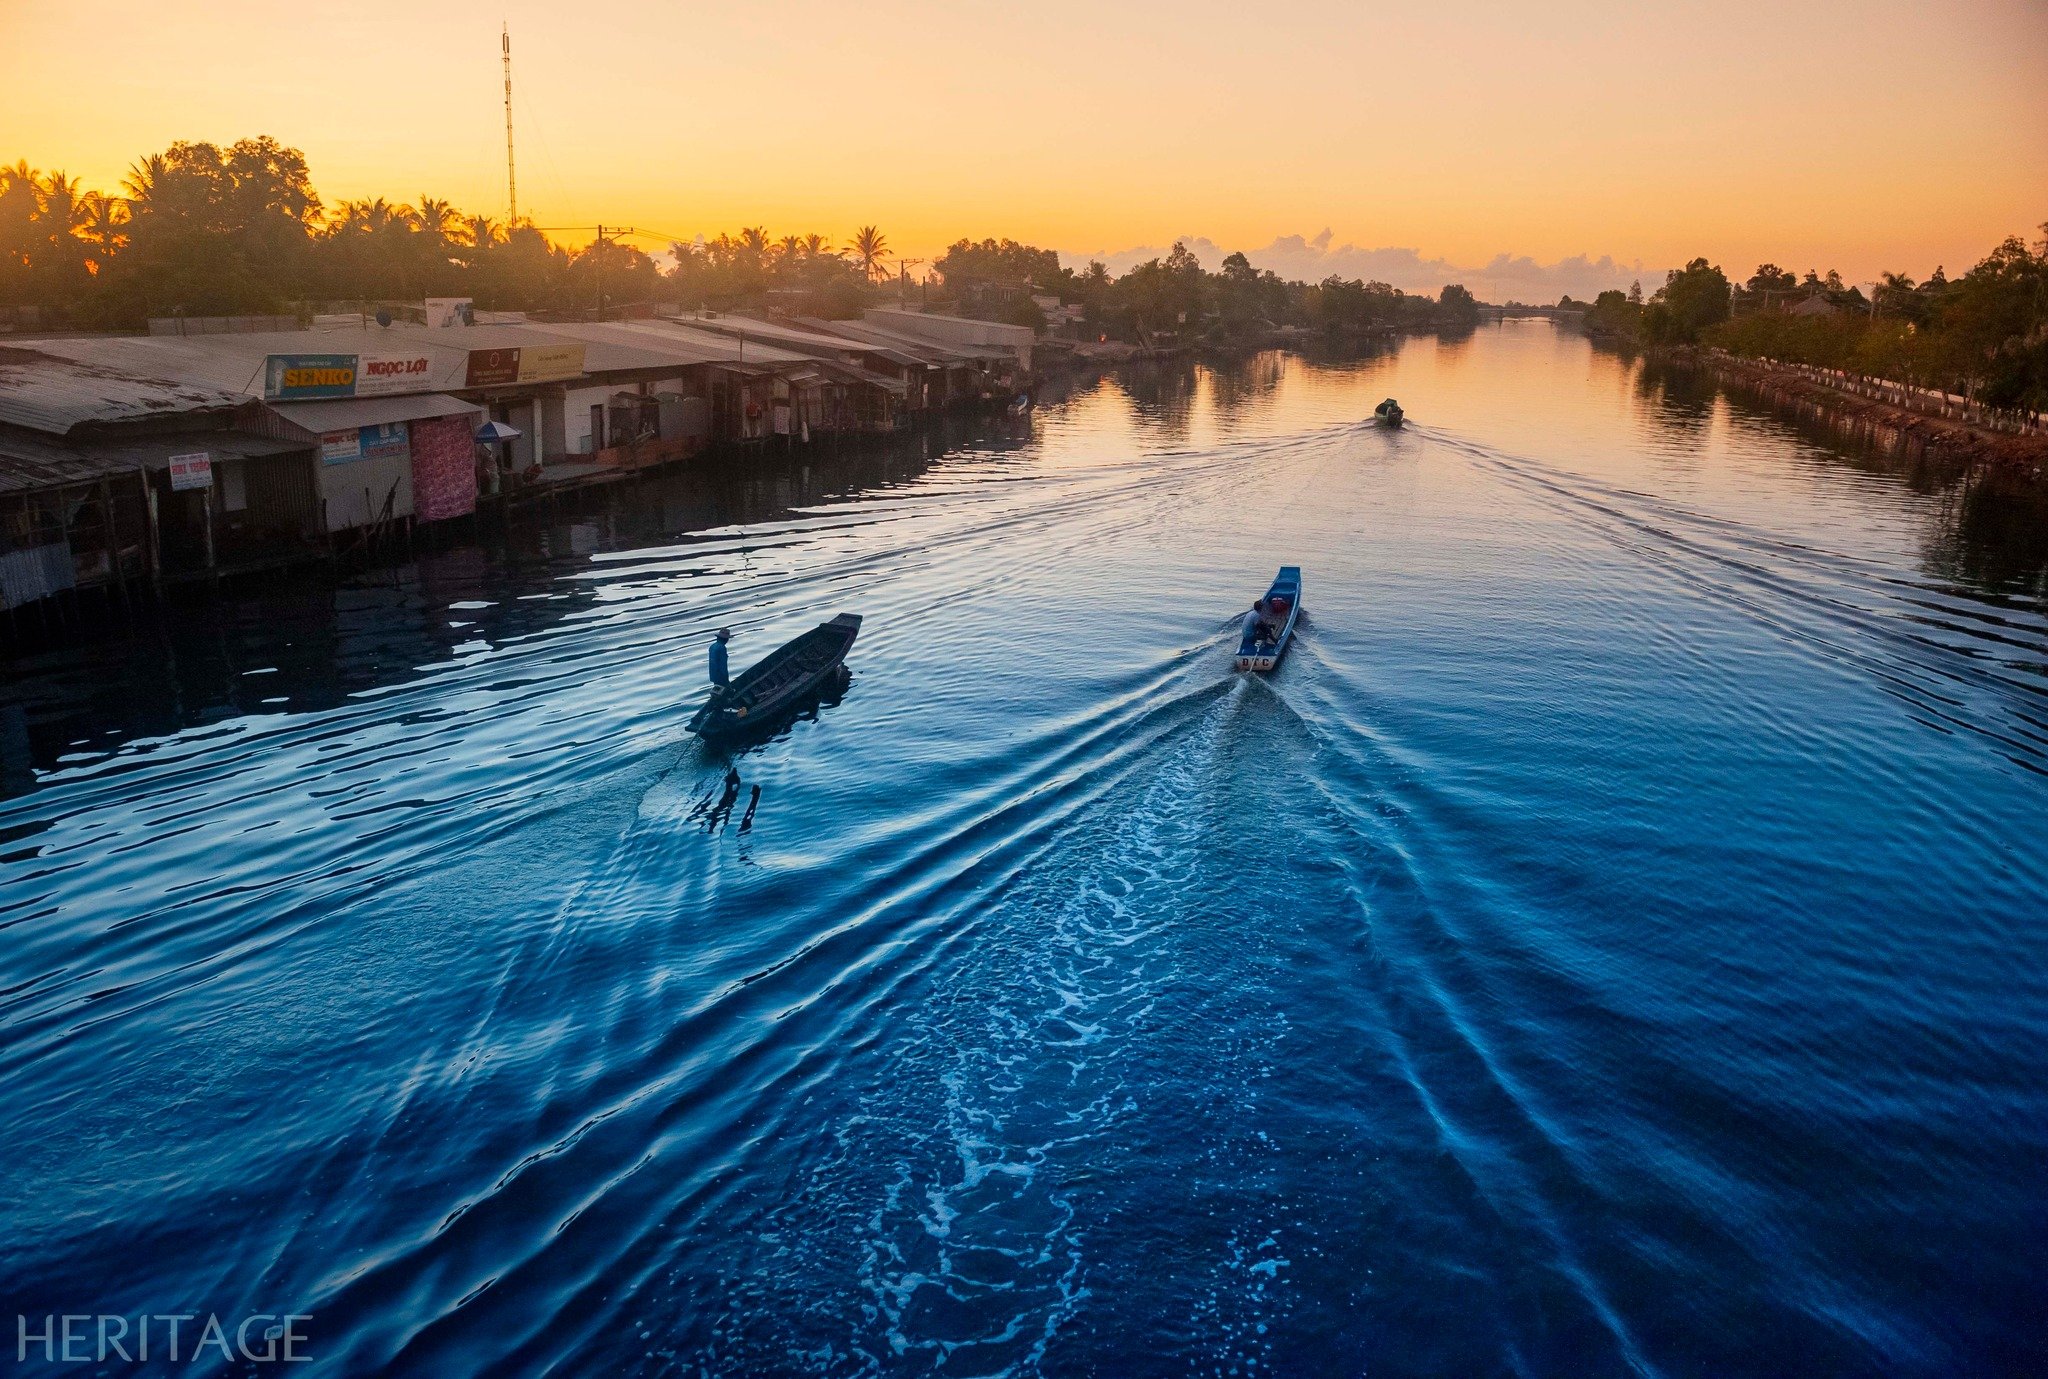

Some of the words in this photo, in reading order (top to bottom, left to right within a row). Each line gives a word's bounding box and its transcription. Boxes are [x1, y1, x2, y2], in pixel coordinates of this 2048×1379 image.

[284, 367, 353, 388] SENKO
[366, 361, 404, 377] NGỌC
[406, 358, 428, 375] LỢI
